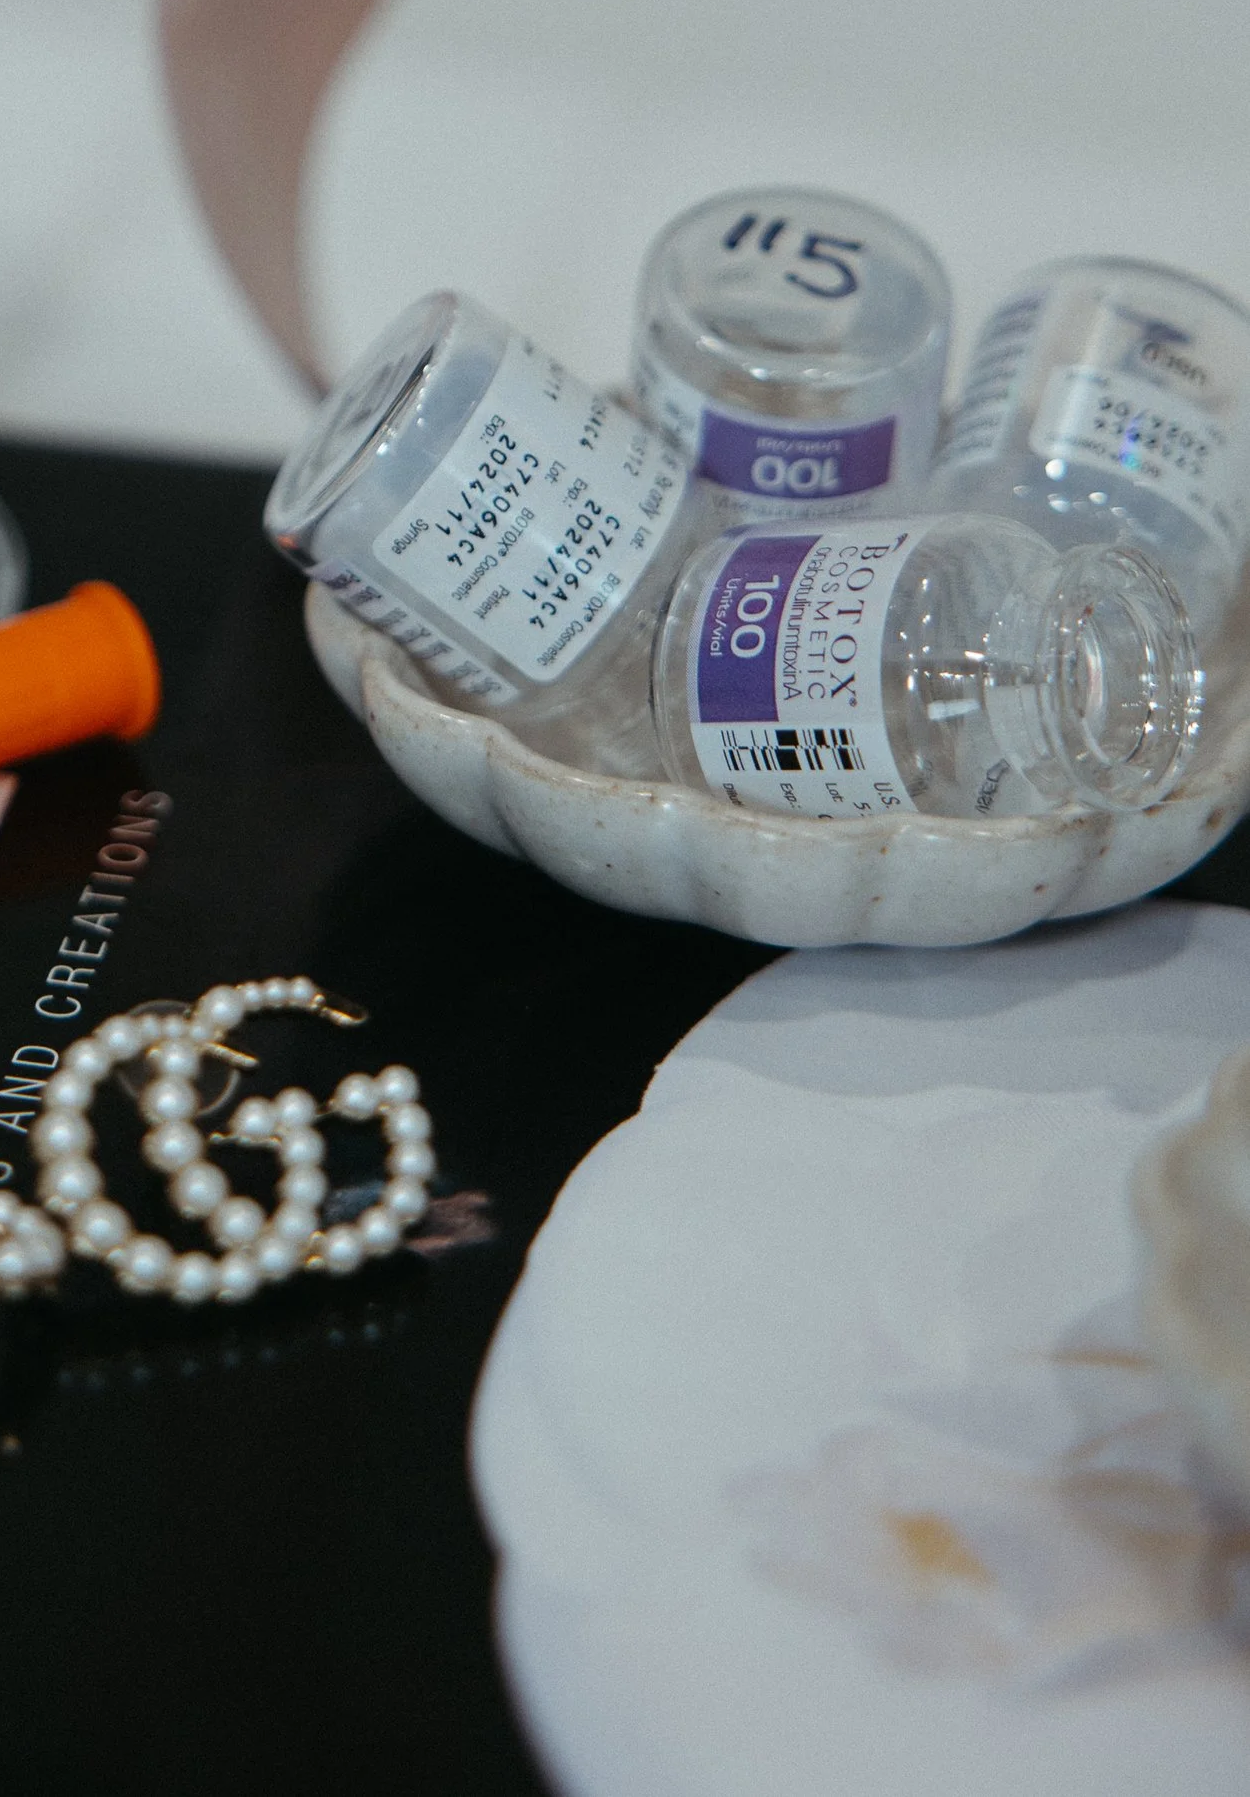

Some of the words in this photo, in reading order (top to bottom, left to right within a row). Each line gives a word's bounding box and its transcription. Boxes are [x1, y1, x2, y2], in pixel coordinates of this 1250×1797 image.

[435, 434, 516, 536] 2024/11
[447, 453, 539, 568] C7406AC4
[751, 455, 840, 495] 100
[391, 518, 430, 555] Syringe
[451, 555, 499, 601] Cosmetic
[522, 499, 602, 601] 2024/11
[530, 515, 620, 630] C7406AC4
[473, 584, 510, 620] Patient
[536, 620, 584, 667] Cosmetic
[710, 578, 741, 657] Units/vial
[730, 574, 781, 659] 100
[783, 546, 832, 701] onabotulinumtoxinA
[807, 545, 858, 700] COSMETIC
[35, 789, 173, 1021] CREATIONS
